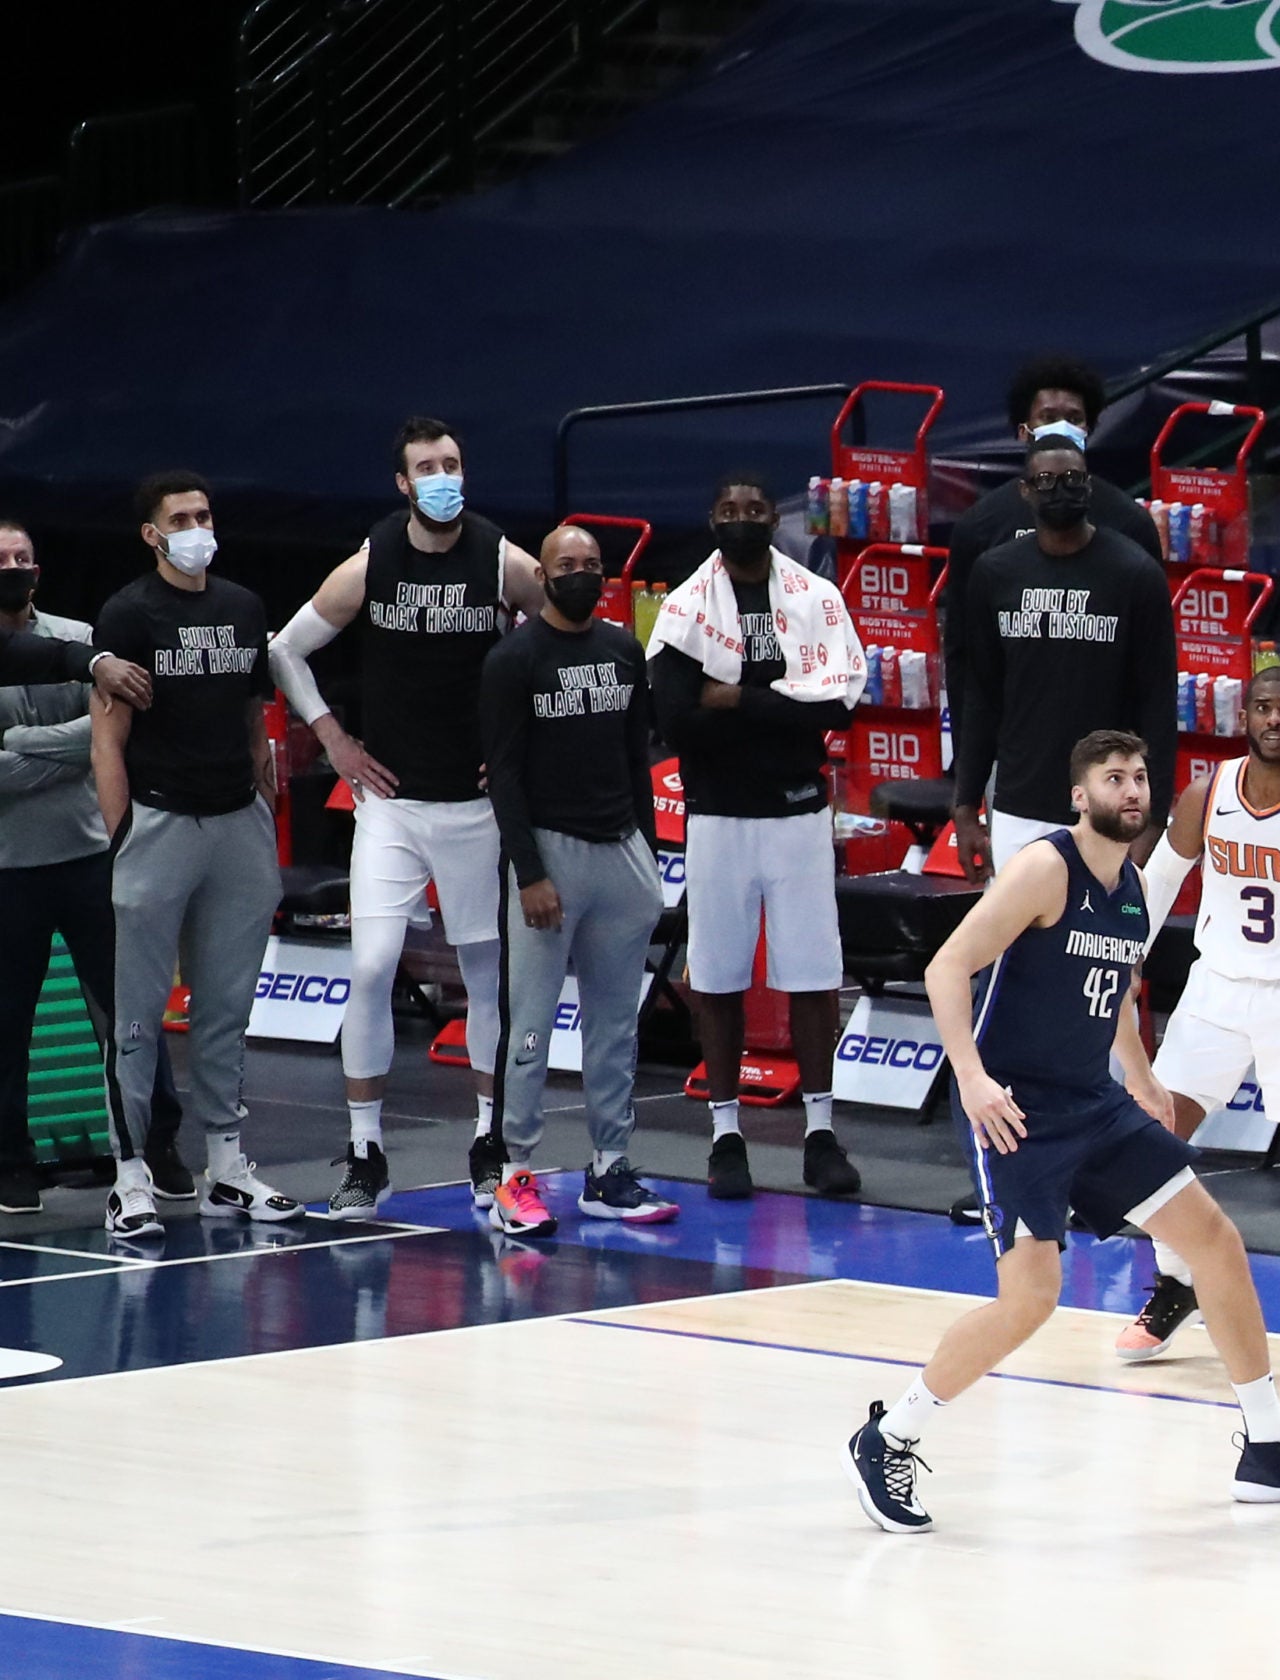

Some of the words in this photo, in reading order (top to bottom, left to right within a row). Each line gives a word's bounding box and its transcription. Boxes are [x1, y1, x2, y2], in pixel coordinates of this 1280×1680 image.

[861, 564, 909, 595] BIO
[396, 582, 442, 608] BUILT
[444, 583, 467, 607] BY
[861, 595, 909, 611] STEEL
[1021, 588, 1065, 612] BUILT
[1066, 589, 1090, 613] BY
[370, 600, 419, 632] BLACK
[426, 605, 494, 633] HISTORY
[998, 611, 1042, 638] BLACK
[1048, 612, 1118, 642] HISTORY
[1181, 619, 1230, 636] STEEL
[178, 626, 216, 650] BUILT
[216, 625, 236, 648] BY
[155, 649, 204, 676] BLACK
[558, 664, 597, 691] BUILT
[596, 662, 617, 686] BY
[533, 689, 585, 718] BLACK
[869, 731, 920, 763] BIO
[870, 762, 921, 779] STEEL
[1240, 886, 1275, 944] 3
[254, 972, 351, 1005] GEICO
[1083, 966, 1119, 1018] 42
[836, 1034, 944, 1071] GEICO
